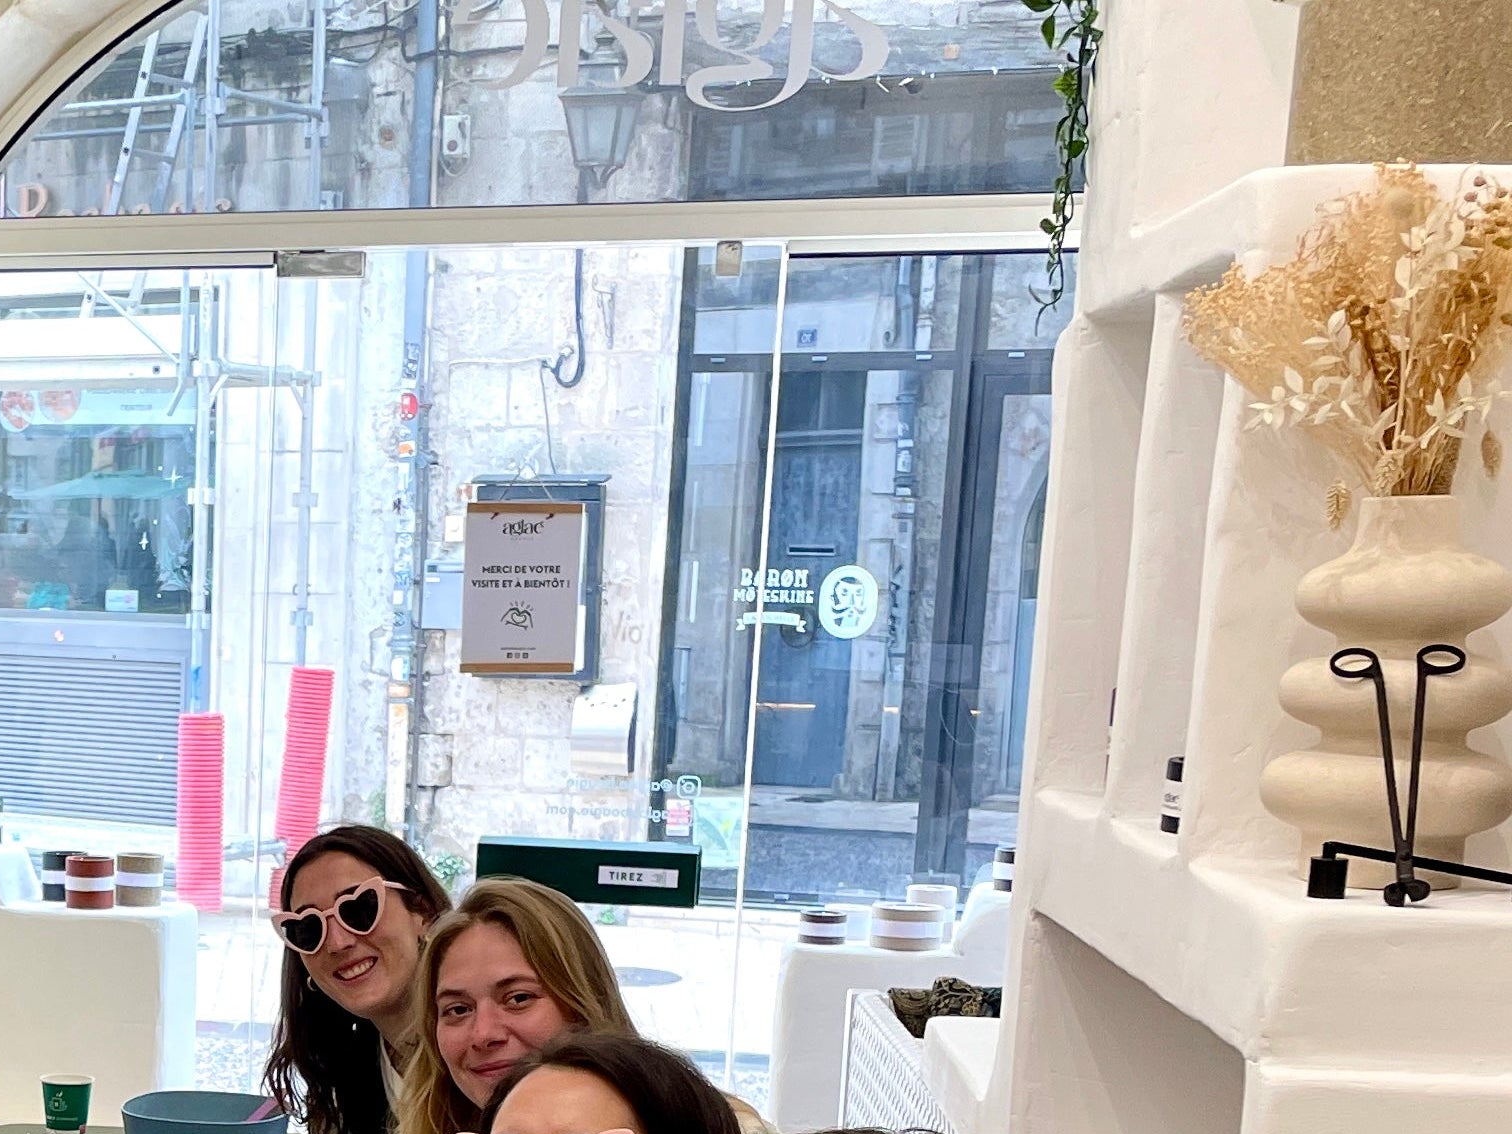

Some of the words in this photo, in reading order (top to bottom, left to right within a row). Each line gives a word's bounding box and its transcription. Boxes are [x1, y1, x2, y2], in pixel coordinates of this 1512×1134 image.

[482, 565, 512, 574] MERCI
[514, 565, 526, 574] DE
[529, 565, 561, 574] VOTRE
[471, 579, 500, 588] VISITE
[502, 579, 513, 588] ET
[514, 577, 522, 588] À
[524, 577, 565, 588] BIENTÔT
[609, 871, 644, 882] TIREZ
